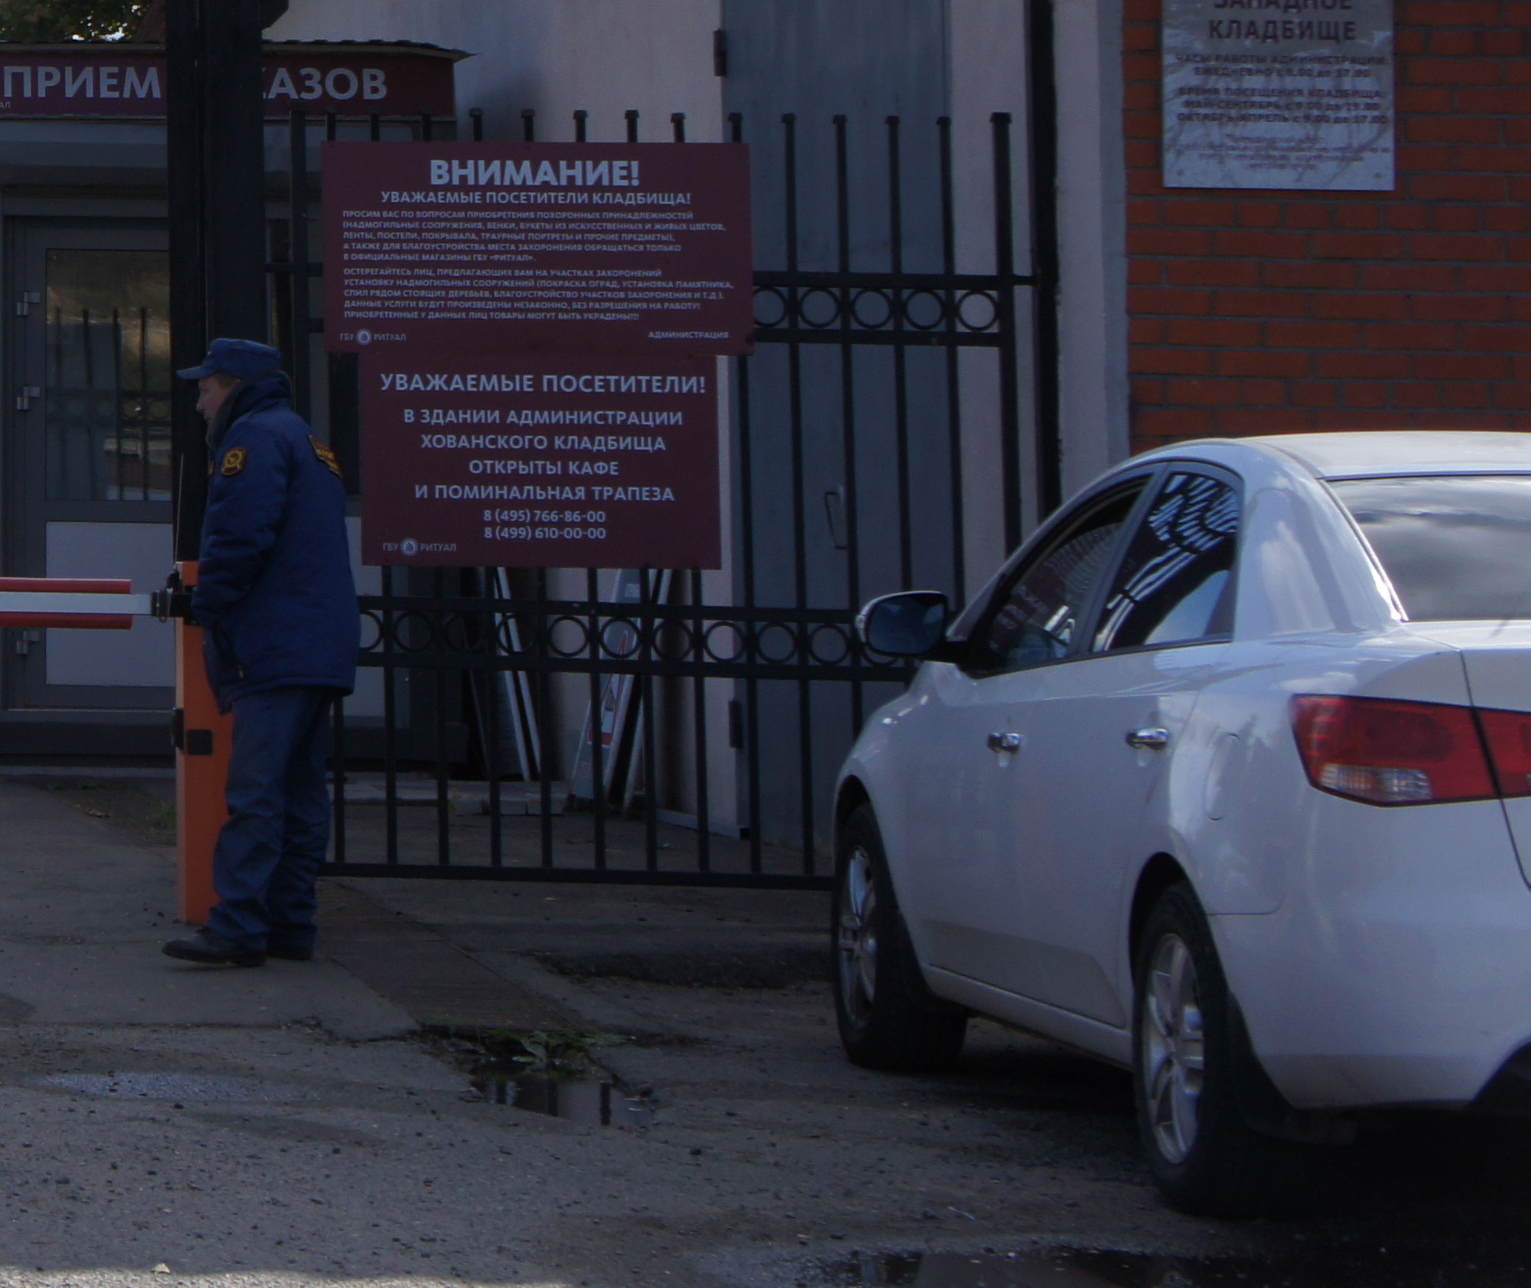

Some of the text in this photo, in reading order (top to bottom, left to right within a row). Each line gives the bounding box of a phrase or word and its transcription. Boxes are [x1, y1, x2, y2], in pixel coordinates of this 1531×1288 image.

[1209, 20, 1356, 44] КЛАДБИЩЕ
[4, 66, 387, 100] ПРИЕМ АЗОВ
[431, 160, 639, 186] ВНИМАНИЕ!
[381, 192, 690, 206] УВАЖАЕМЫЕ ПОСЕТИТЕЛИ КЛАДБИЩА!
[343, 210, 380, 218] ПРОСИМ
[602, 211, 693, 219] ПРИНАДЛЕЖНОСТЕЙ
[351, 242, 380, 250] ТАКЖЕ
[584, 244, 644, 252] ОБРАЩАТЬСЯ
[351, 253, 419, 261] ОФИЦИАЛЬНЫЕ
[343, 267, 411, 275] ОСТЕРЕГАЙТЕСЬ
[596, 269, 661, 277] ЗАХОРОНЕНИЙ
[473, 279, 535, 287] СООРУЖЕНИЙ
[537, 280, 587, 288] (ПОКРАСКА
[589, 280, 620, 288] ОГРАД,
[344, 300, 381, 308] ДАННЫЕ
[447, 301, 511, 309] ПРОИЗВЕДЕНЫ
[340, 333, 406, 341] ГБУ РИТУАЛ
[649, 331, 729, 339] АДМИНИСТРАЦИЯ
[381, 374, 705, 393] УВАЖАЕМЫЕ ПОСЕТИТЕЛИ!
[404, 409, 682, 427] В ЗДАНИИ АДМИНИСТРАЦИИ
[421, 434, 665, 452] ХОВАНСКОГО КЛАДБИЩА
[469, 460, 618, 475] ОТКРЫТЫ КАФЕ
[415, 485, 674, 500] И ПОМИНАЛЬНАЯ ТРАПЕЗА
[484, 508, 605, 522] 8 (495) 766-86-00
[485, 526, 606, 540] 8 (499) 610-00-00
[383, 543, 456, 551] ГБУ РИТУАЛ
